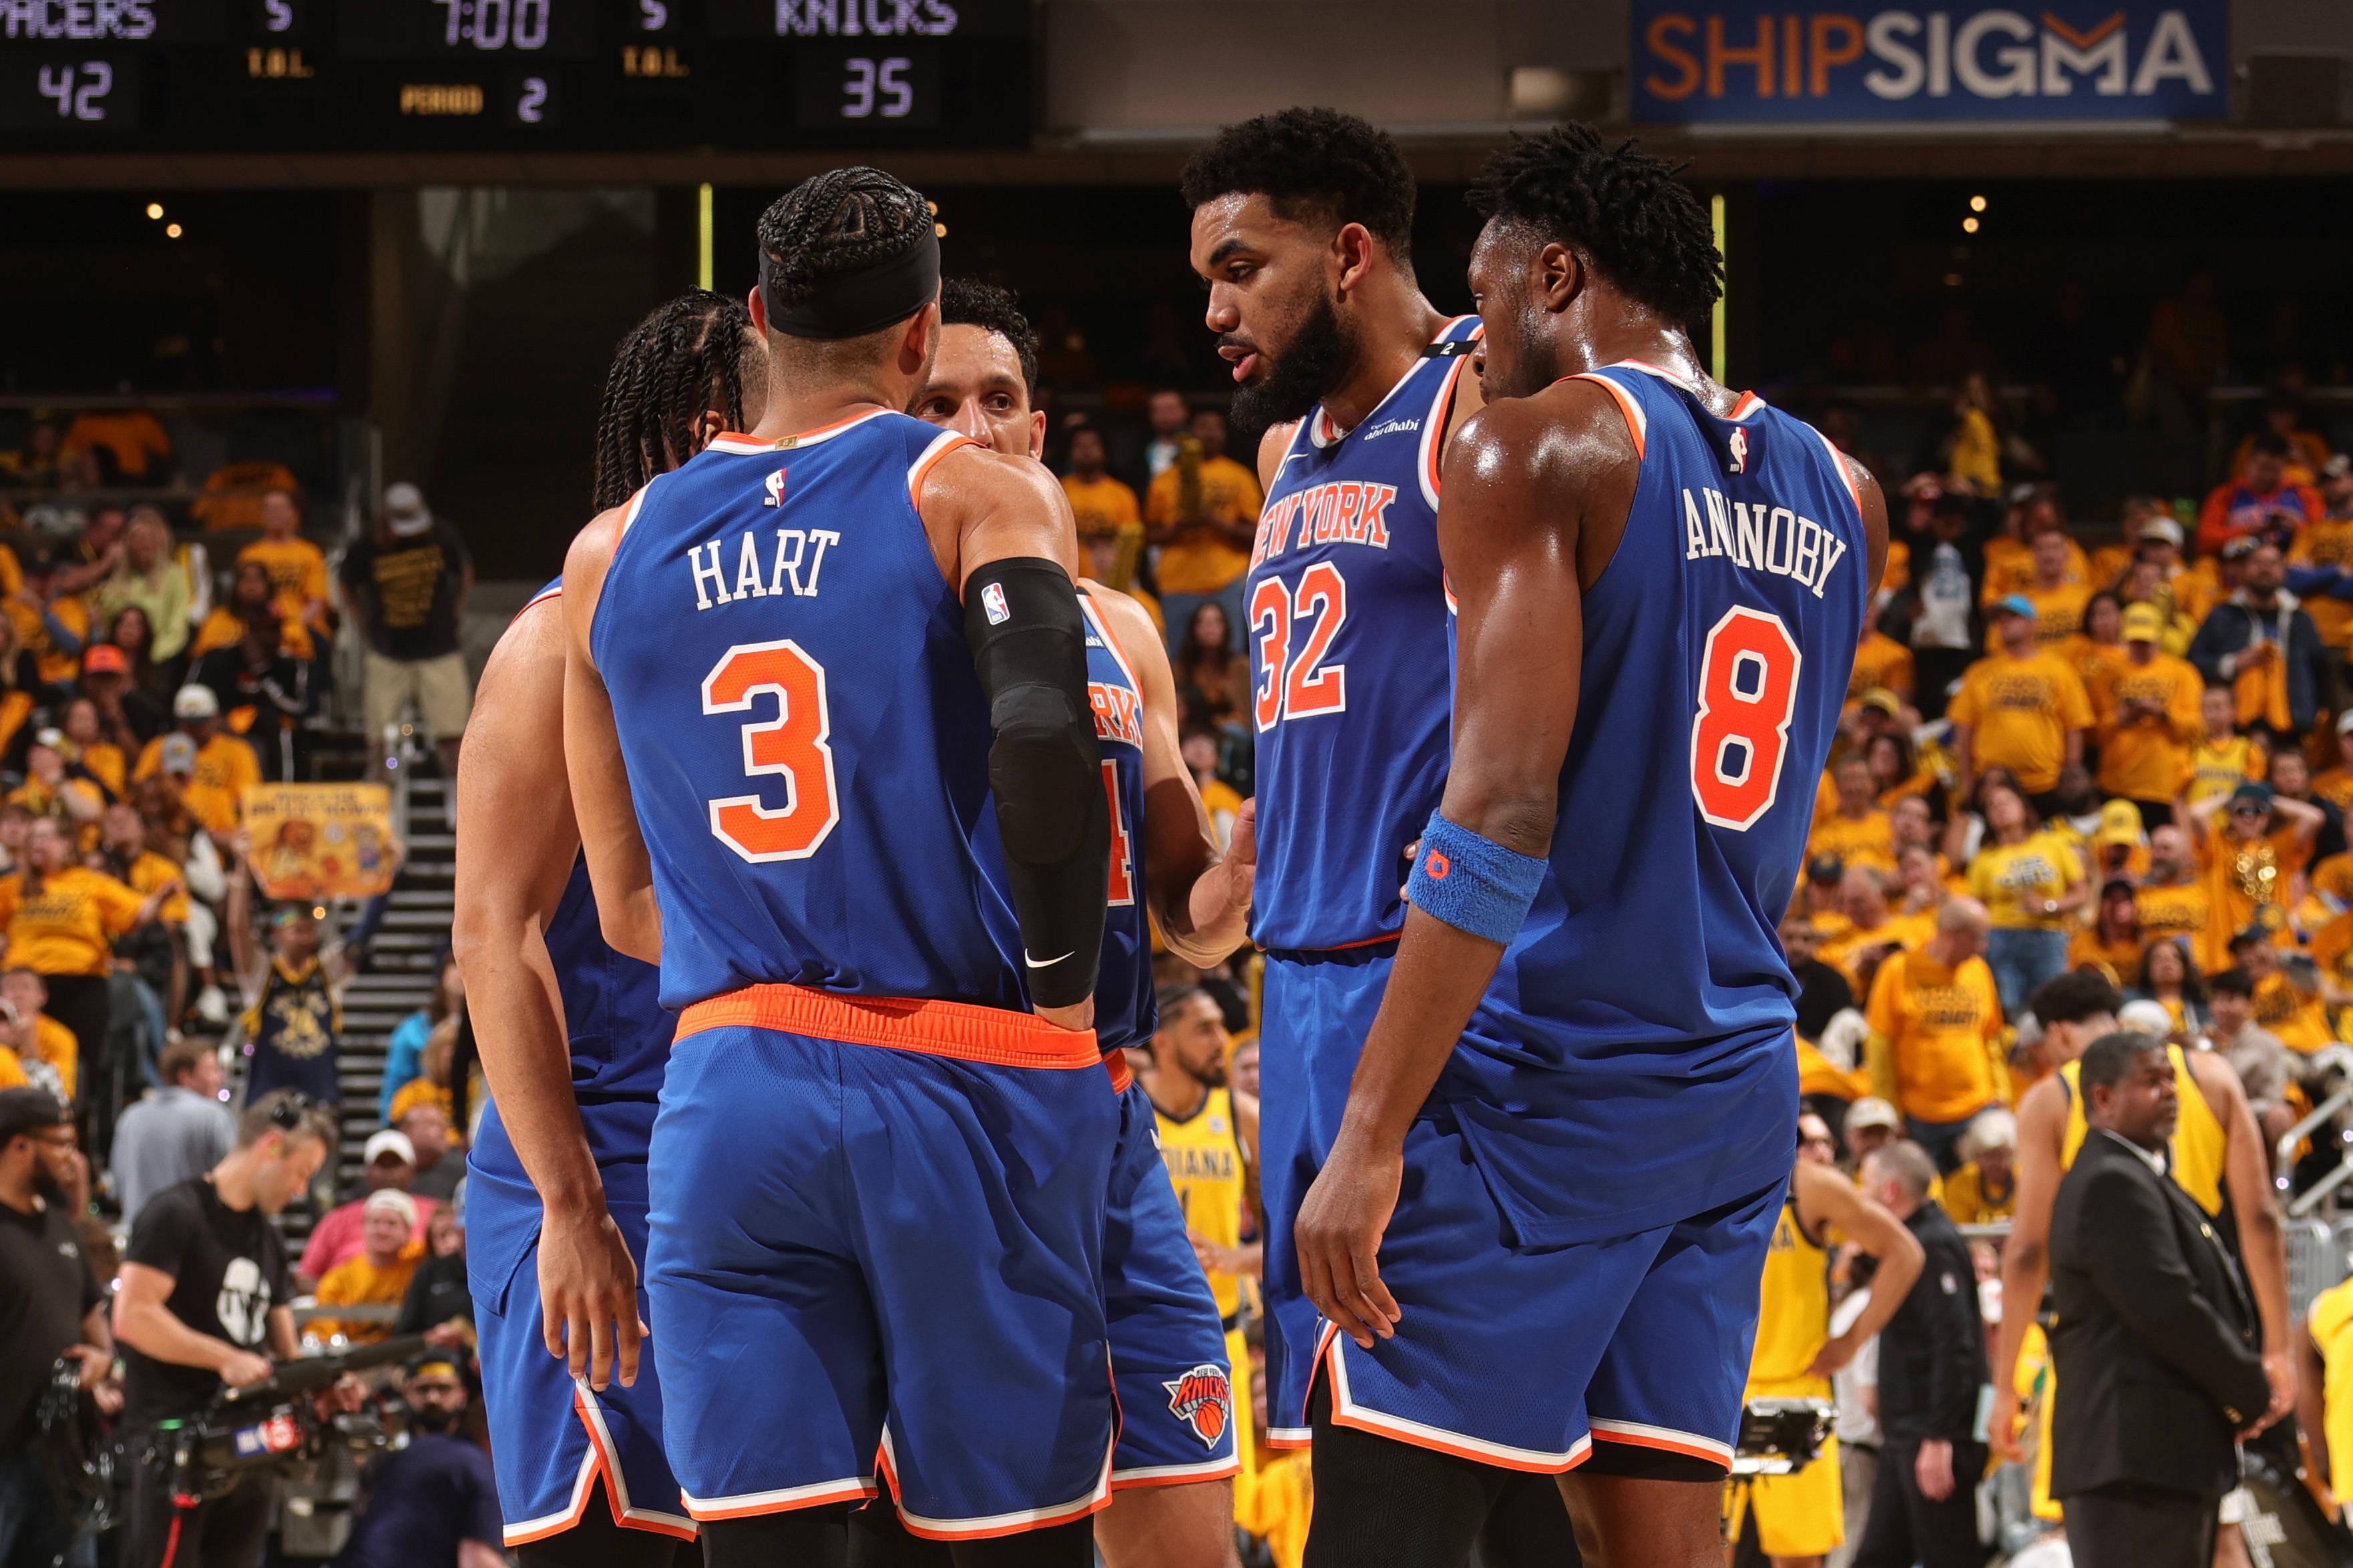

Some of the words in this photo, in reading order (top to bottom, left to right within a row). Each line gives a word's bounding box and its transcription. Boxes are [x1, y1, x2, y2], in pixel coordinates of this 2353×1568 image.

[0, 0, 156, 39] ACERS
[775, 0, 958, 36] KNICKS
[1645, 11, 2214, 100] SHIPSIGMA
[38, 61, 112, 120] 42
[401, 85, 483, 115] PERIOD
[518, 77, 548, 123] 2
[841, 58, 913, 117] 35
[1383, 419, 1421, 435] dhabi
[1297, 480, 1398, 550] YORK
[1683, 487, 1847, 599] ANNOBY
[688, 529, 841, 611] HART
[1250, 561, 1346, 734] 32
[1690, 604, 1802, 832] 8
[701, 638, 840, 864] 3
[1172, 1374, 1230, 1408] KNICKS
